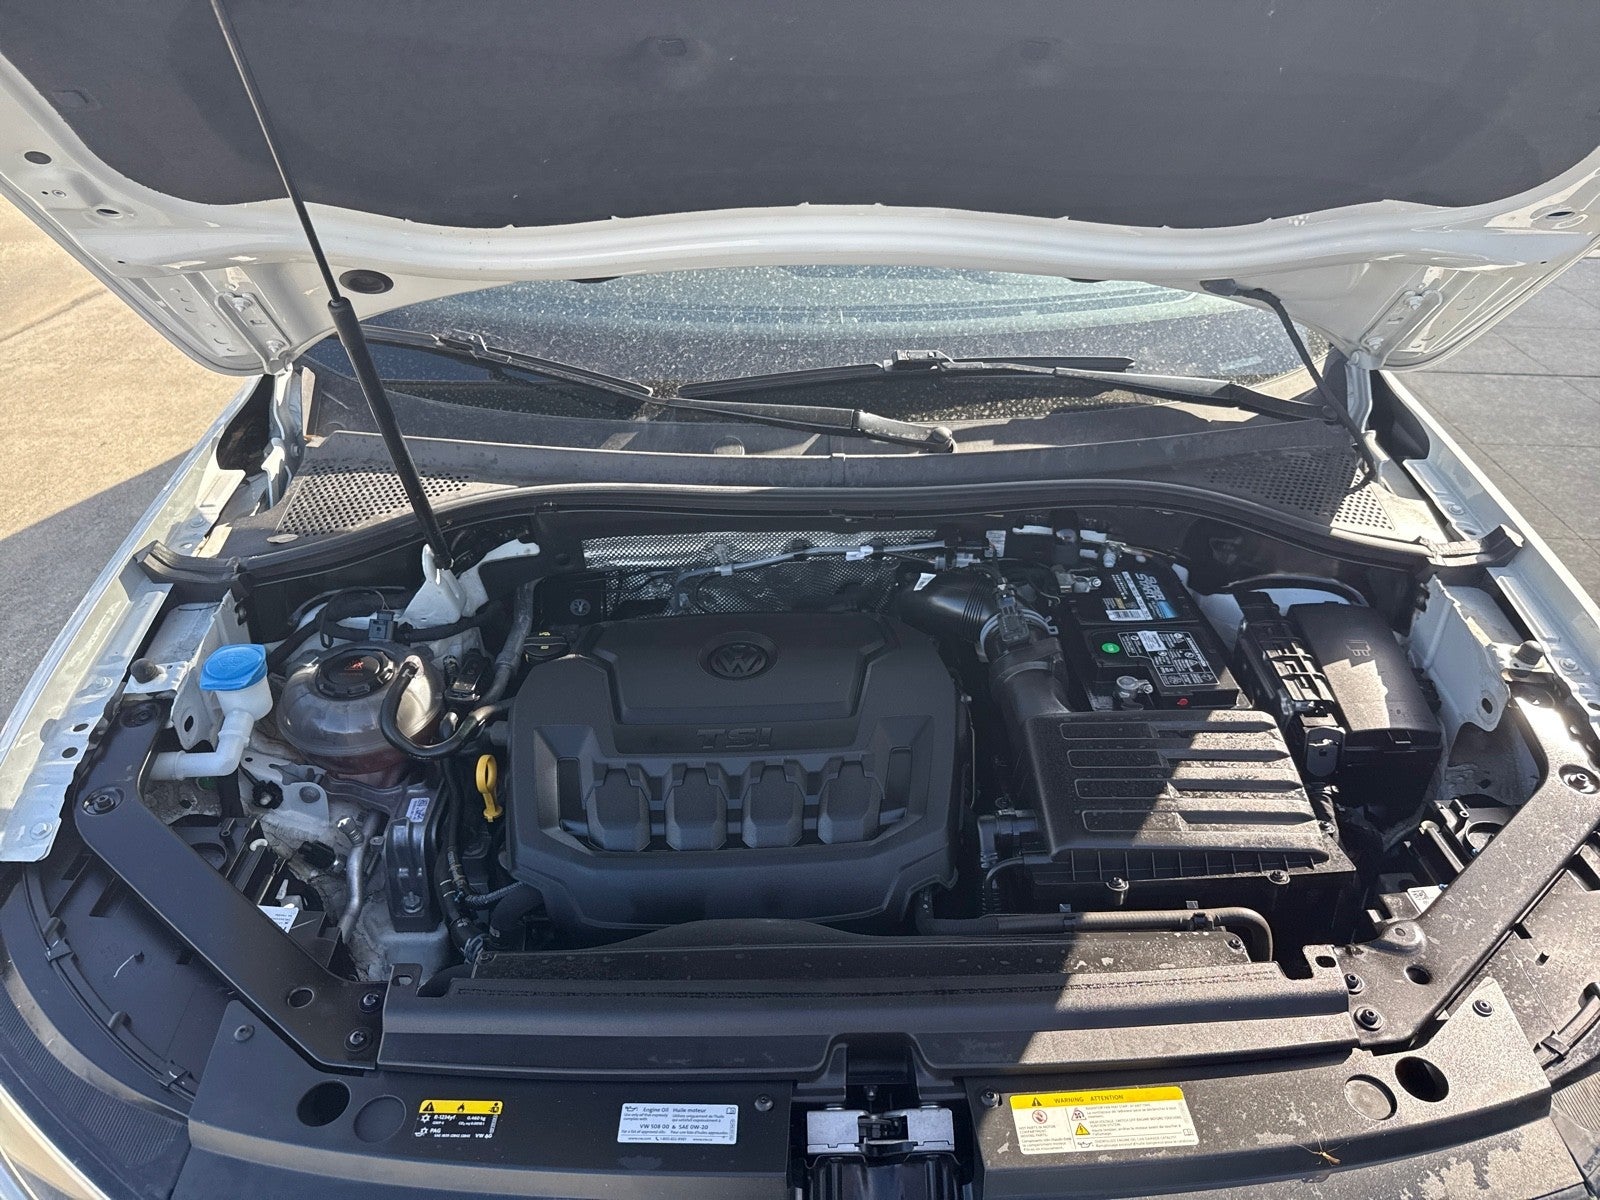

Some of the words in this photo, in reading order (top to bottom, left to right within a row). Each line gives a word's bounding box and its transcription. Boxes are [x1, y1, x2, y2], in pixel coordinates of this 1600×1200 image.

[697, 727, 773, 749] TSI
[1053, 1096, 1084, 1104] WARNING
[1090, 1094, 1124, 1102] ATTENTION
